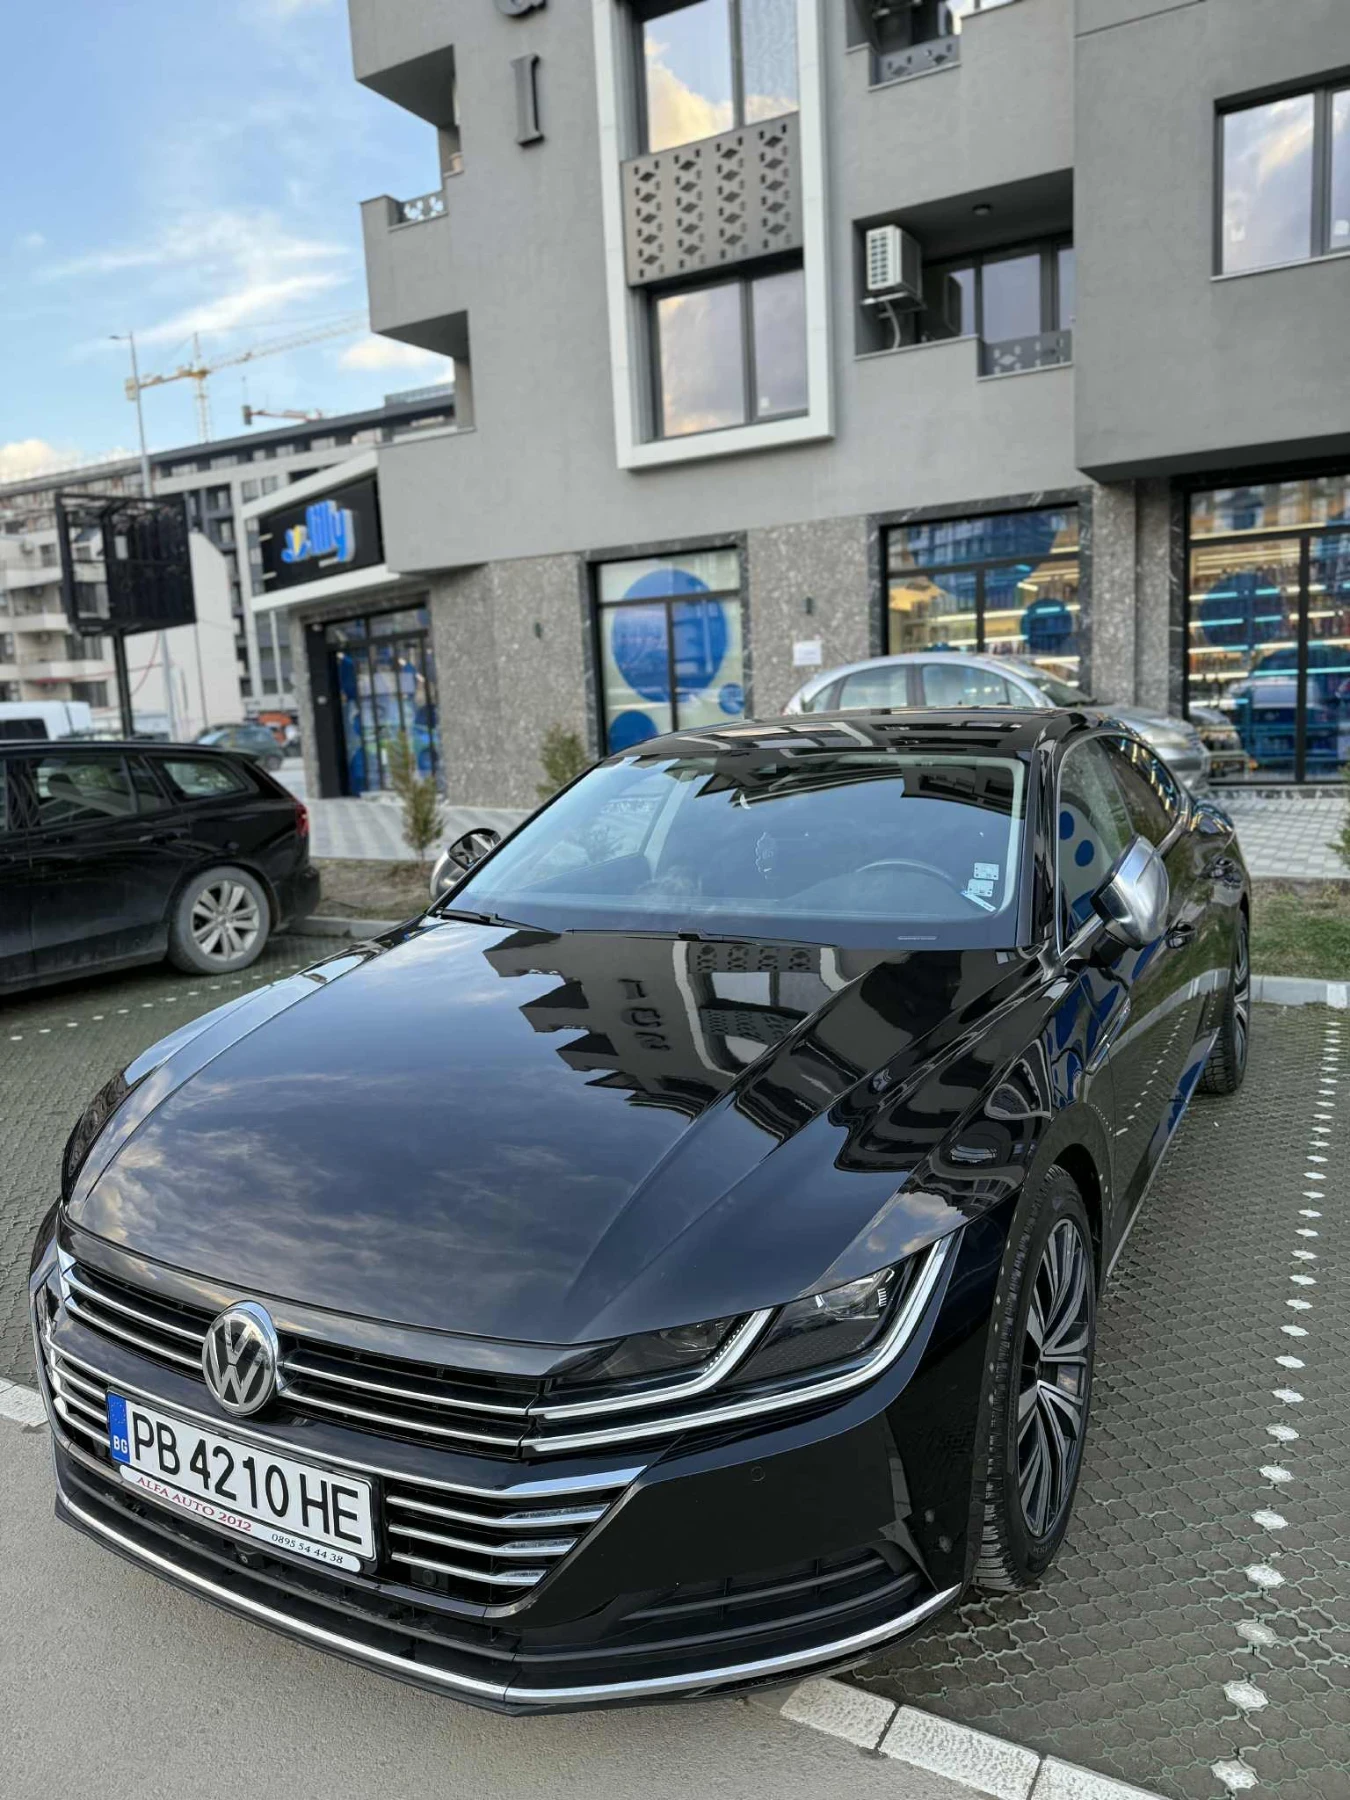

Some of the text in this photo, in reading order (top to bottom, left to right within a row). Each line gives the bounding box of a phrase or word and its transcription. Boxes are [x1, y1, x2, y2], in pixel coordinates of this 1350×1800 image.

[113, 1435, 128, 1454] BG
[132, 1410, 362, 1545] PB 4210 HE
[137, 1477, 252, 1532] ALFA AUTO 2012
[271, 1533, 296, 1548] 0895
